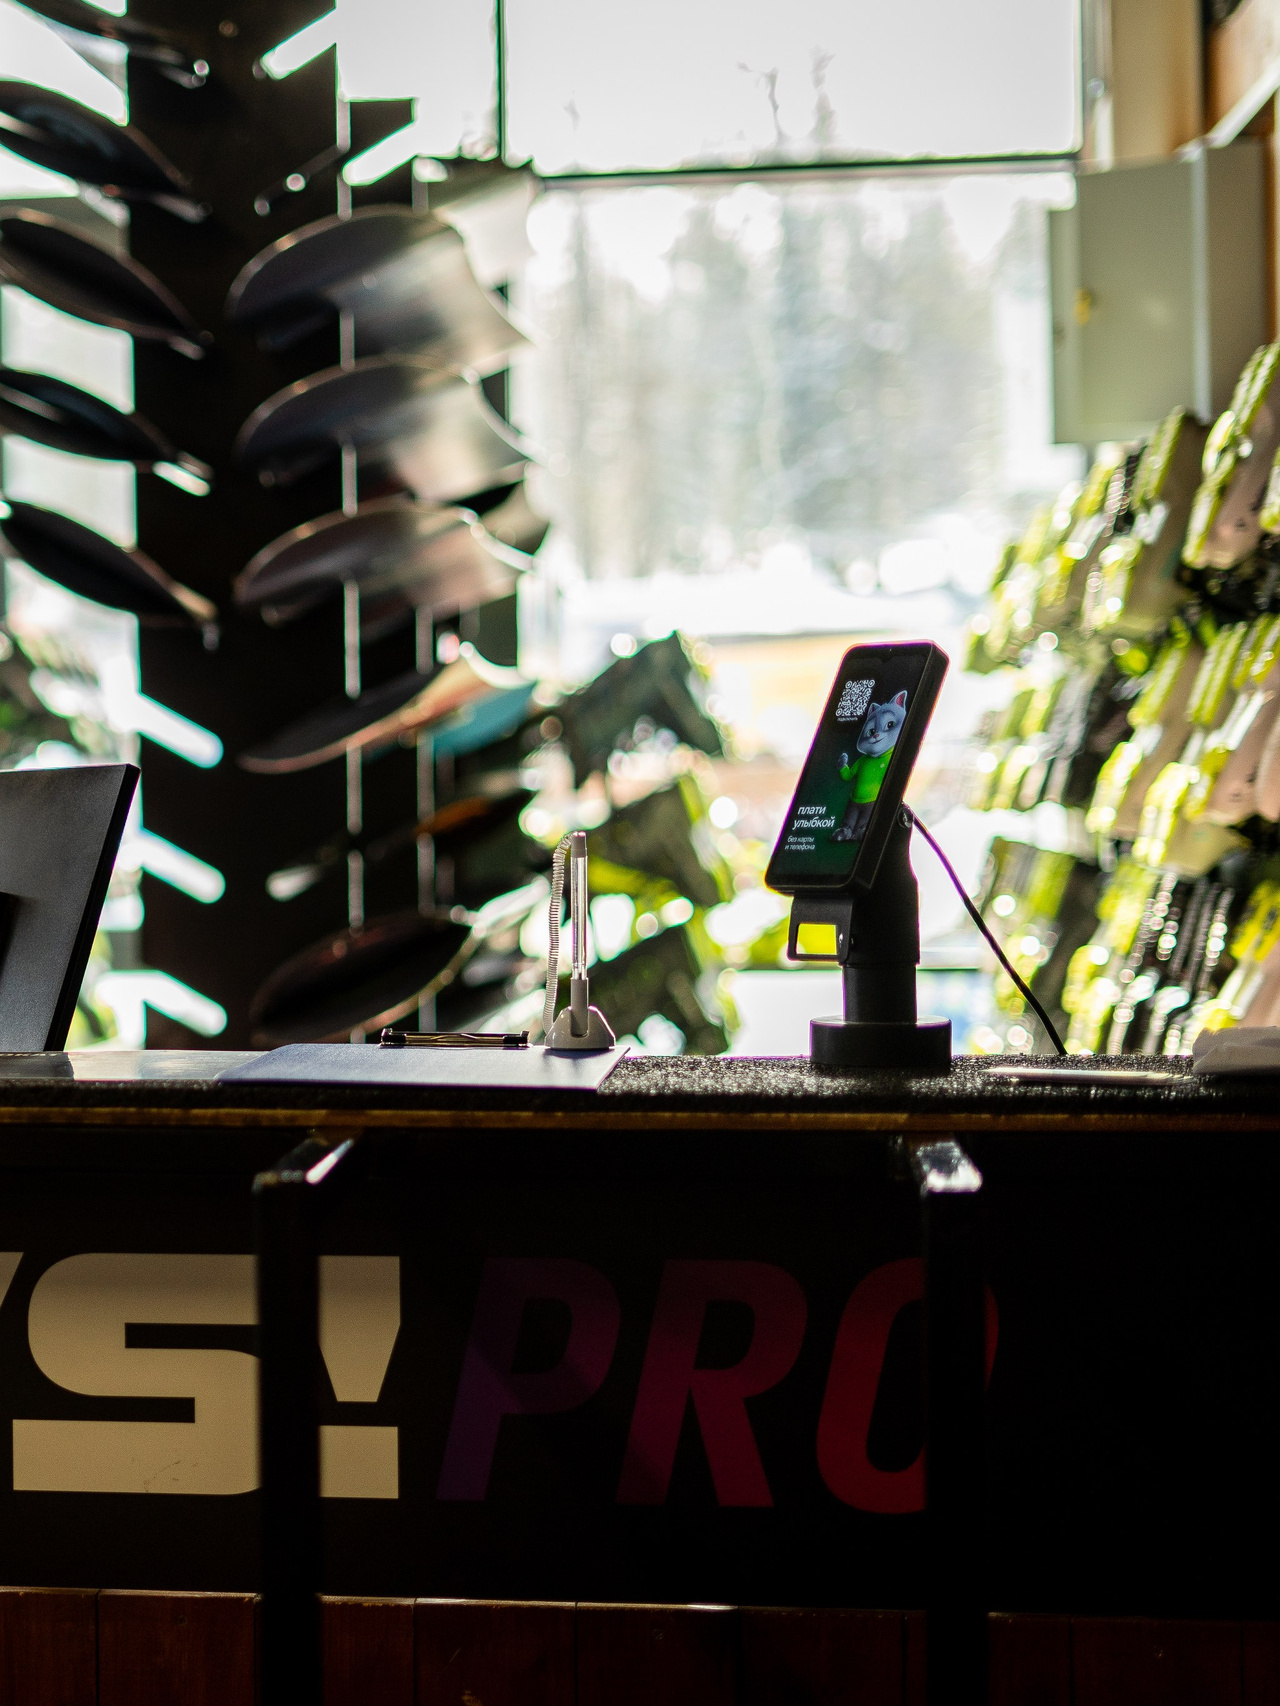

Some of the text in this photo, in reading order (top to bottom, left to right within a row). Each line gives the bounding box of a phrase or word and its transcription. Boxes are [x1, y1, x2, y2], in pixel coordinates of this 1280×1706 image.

[798, 806, 826, 815] плати
[792, 816, 836, 830] улыбкой
[789, 843, 815, 851] телефона
